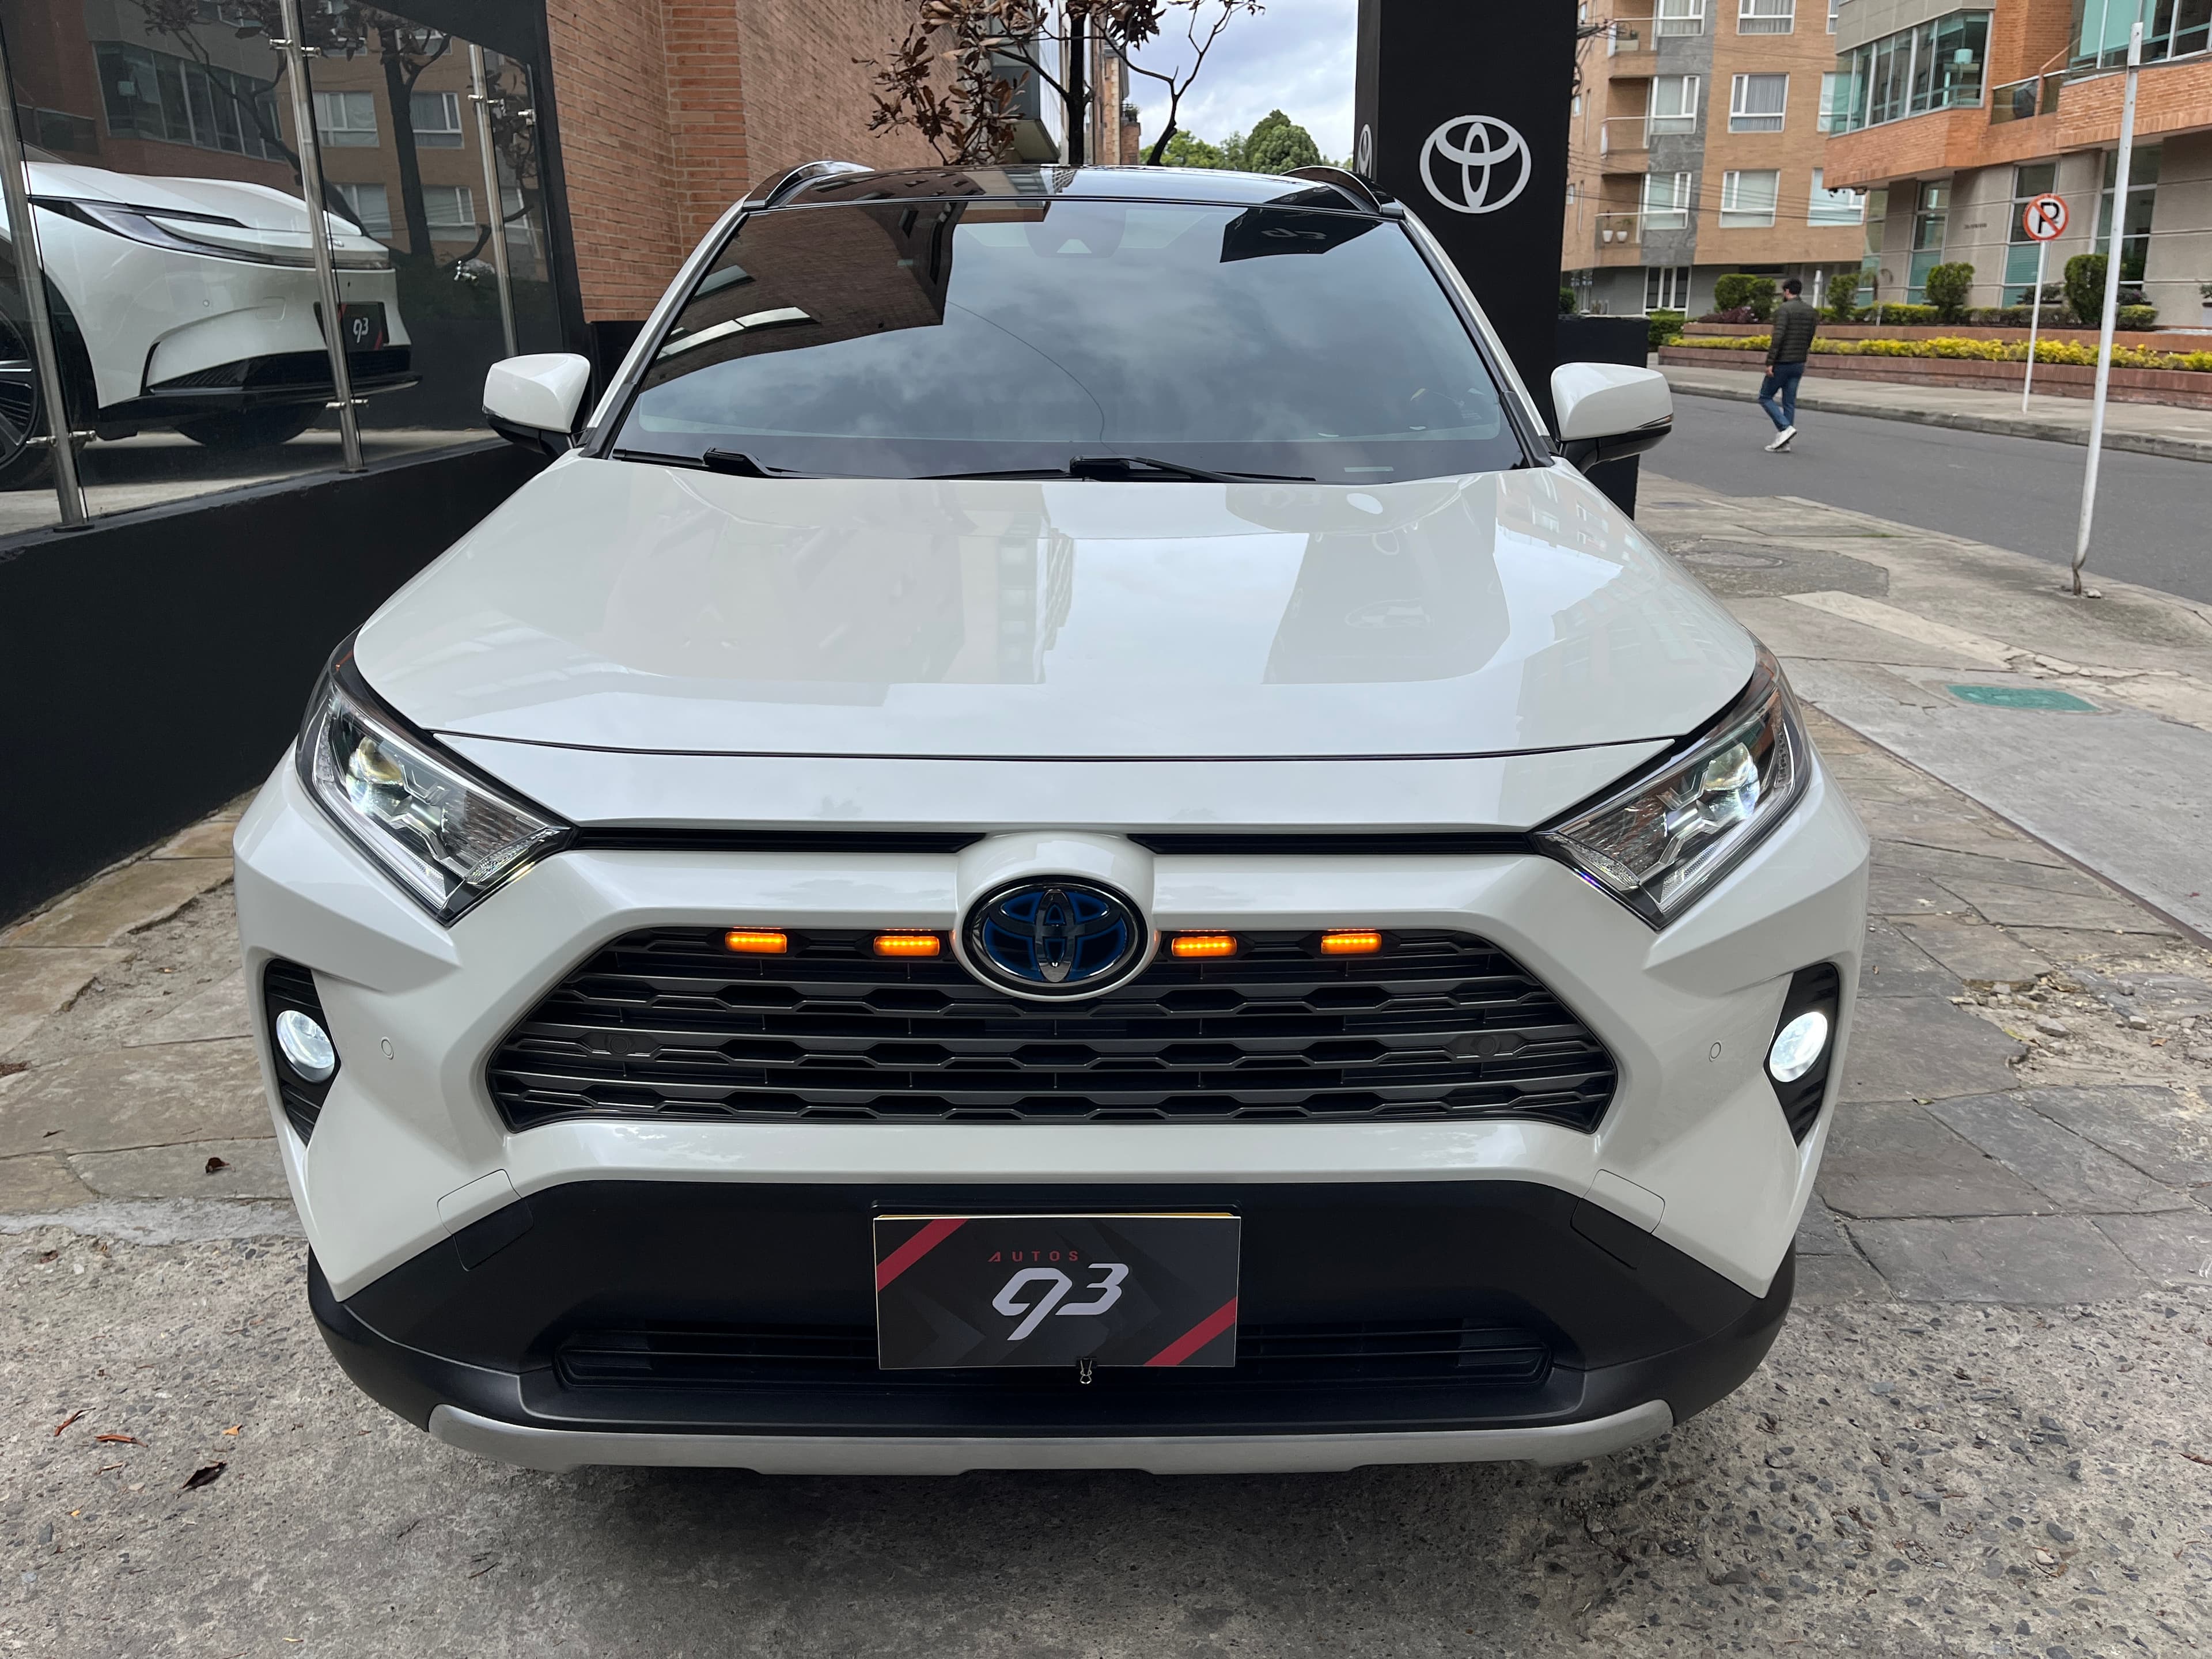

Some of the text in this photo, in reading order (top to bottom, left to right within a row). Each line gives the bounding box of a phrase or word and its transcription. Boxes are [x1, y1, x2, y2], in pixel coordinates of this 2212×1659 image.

[2037, 202, 2059, 234] P
[353, 317, 369, 343] 93
[988, 1250, 1079, 1262] AUTOS
[992, 1263, 1129, 1341] 93
